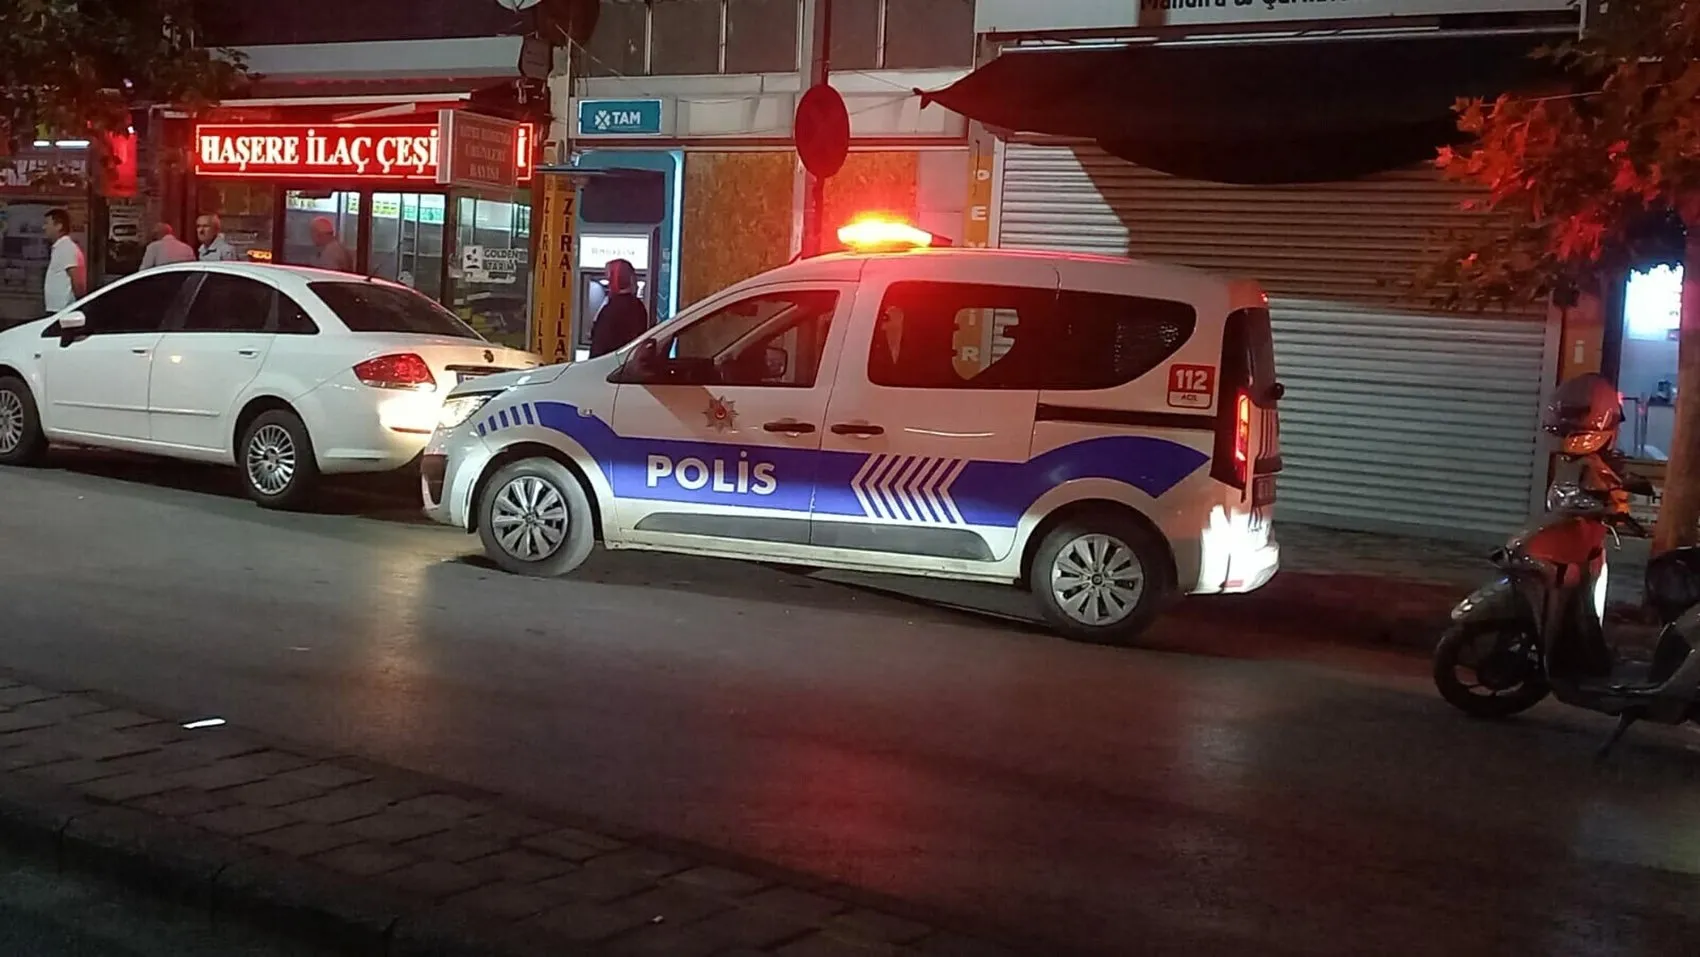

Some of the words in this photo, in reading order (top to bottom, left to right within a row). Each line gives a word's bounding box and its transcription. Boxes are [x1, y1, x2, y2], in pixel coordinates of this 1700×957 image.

[611, 111, 641, 125] TAM
[200, 136, 299, 171] HAŞERE
[306, 129, 371, 173] İLAÇ
[484, 249, 518, 259] GOLDEN
[559, 198, 575, 289] ZİRAİ
[1175, 369, 1208, 391] 112
[646, 450, 777, 495] POLİS
